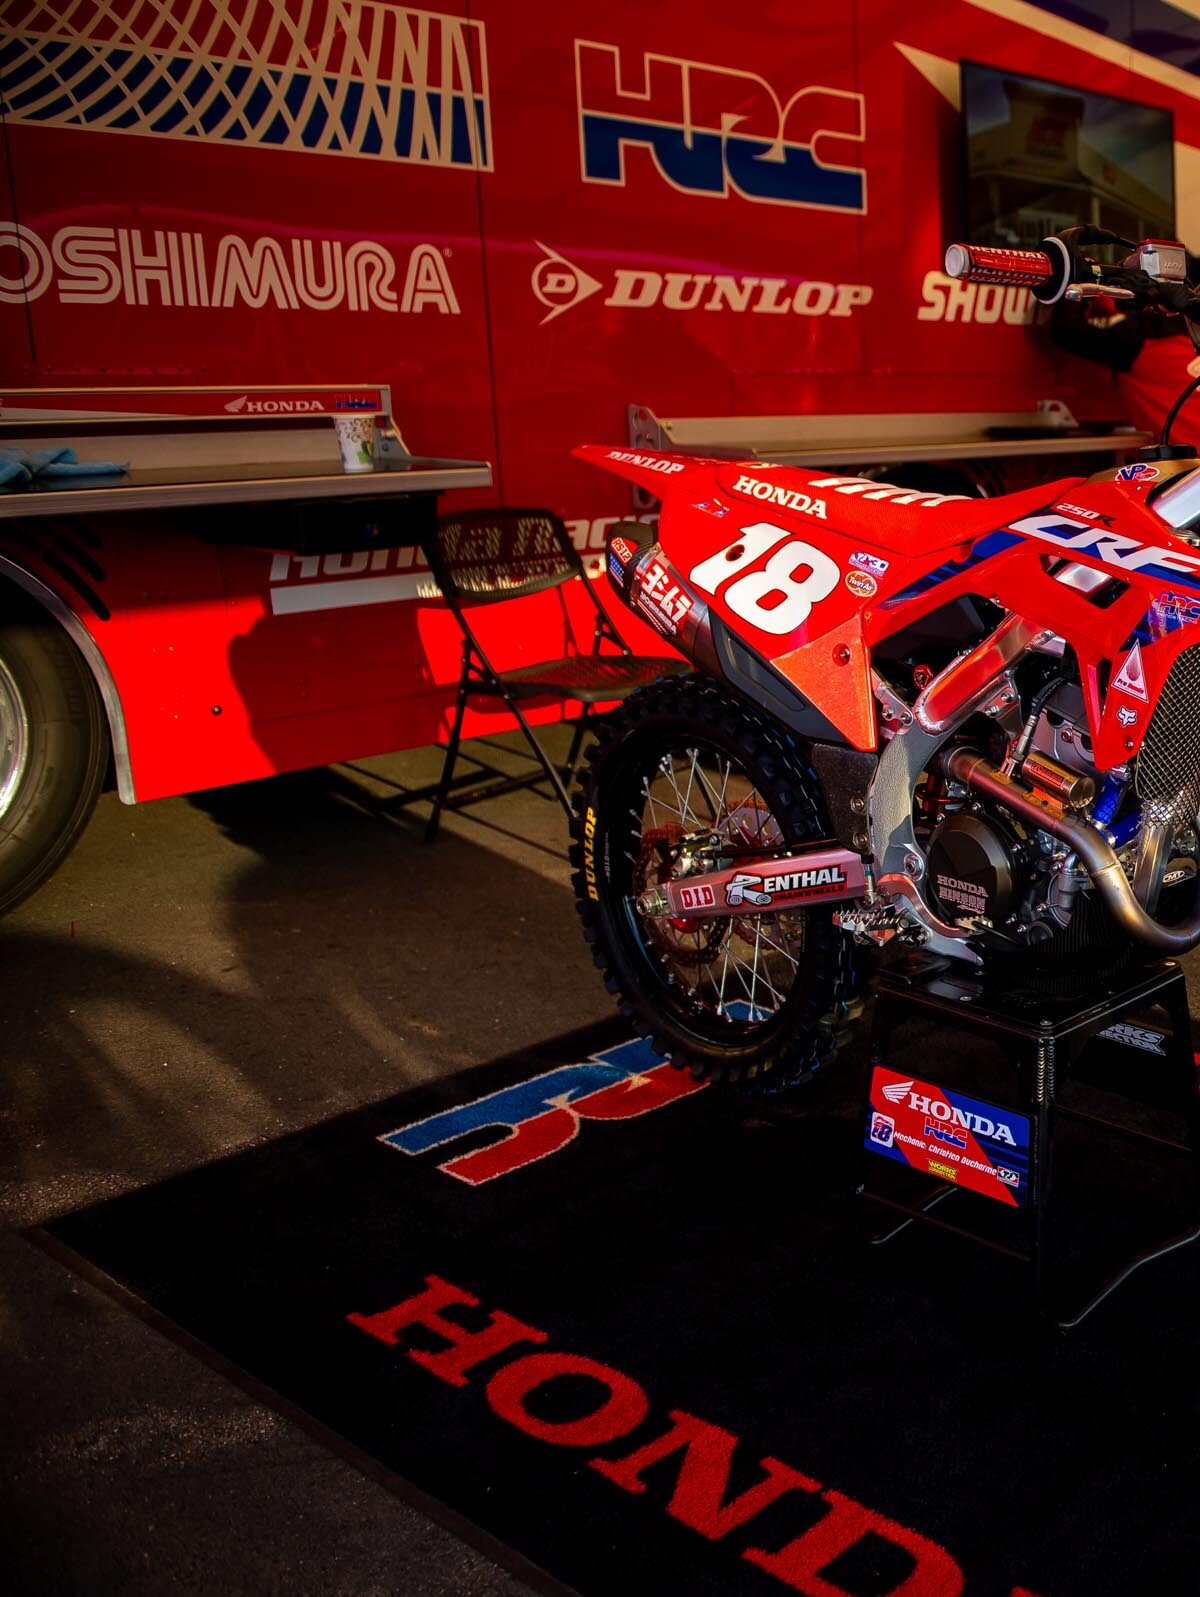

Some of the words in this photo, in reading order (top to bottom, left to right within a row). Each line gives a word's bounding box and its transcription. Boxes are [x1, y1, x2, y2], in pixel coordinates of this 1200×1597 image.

[575, 38, 868, 216] HRC
[604, 269, 874, 317] DUNLOP
[916, 270, 1046, 325] SHOW
[246, 400, 325, 412] HONDA
[605, 450, 685, 475] DUNLOP
[732, 475, 828, 519] HONDA
[689, 521, 841, 635] 18
[585, 806, 599, 901] DUNLOP
[683, 887, 714, 908] D.I.D
[936, 874, 990, 898] HONDA
[893, 1131, 928, 1150] Mechanic:
[907, 1092, 1017, 1146] HONDA
[923, 1116, 968, 1150] HRC
[345, 1273, 1046, 1597] HOND
